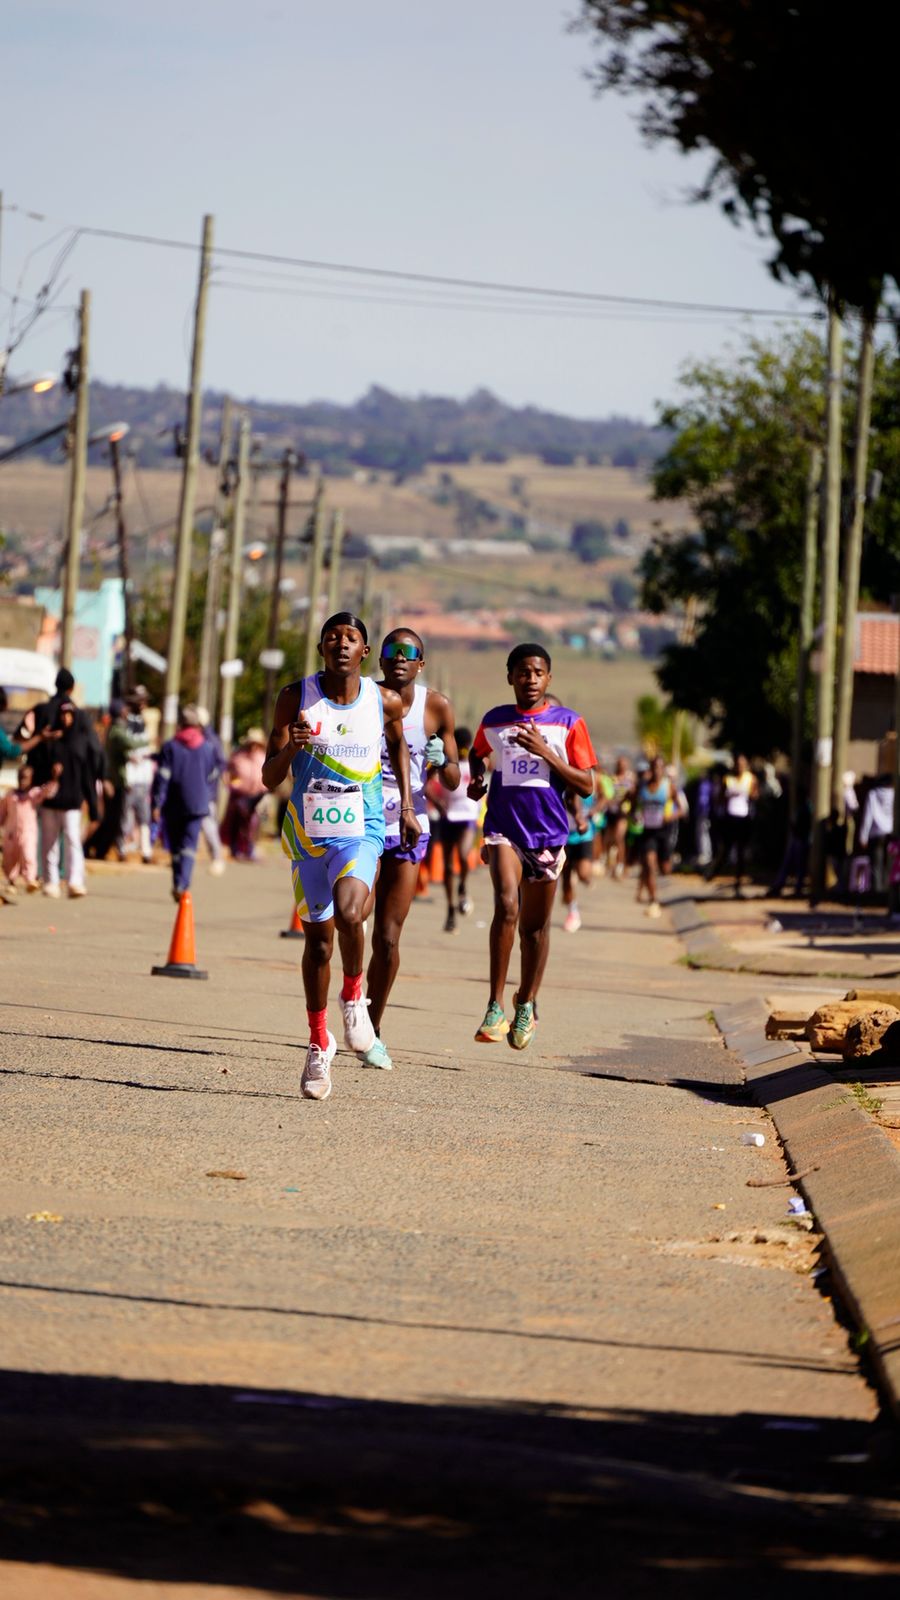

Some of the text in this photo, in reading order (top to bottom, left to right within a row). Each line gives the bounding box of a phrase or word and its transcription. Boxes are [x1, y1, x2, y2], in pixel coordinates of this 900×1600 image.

[312, 744, 370, 758] FootPrint
[511, 760, 540, 775] 182
[312, 807, 356, 824] 406
